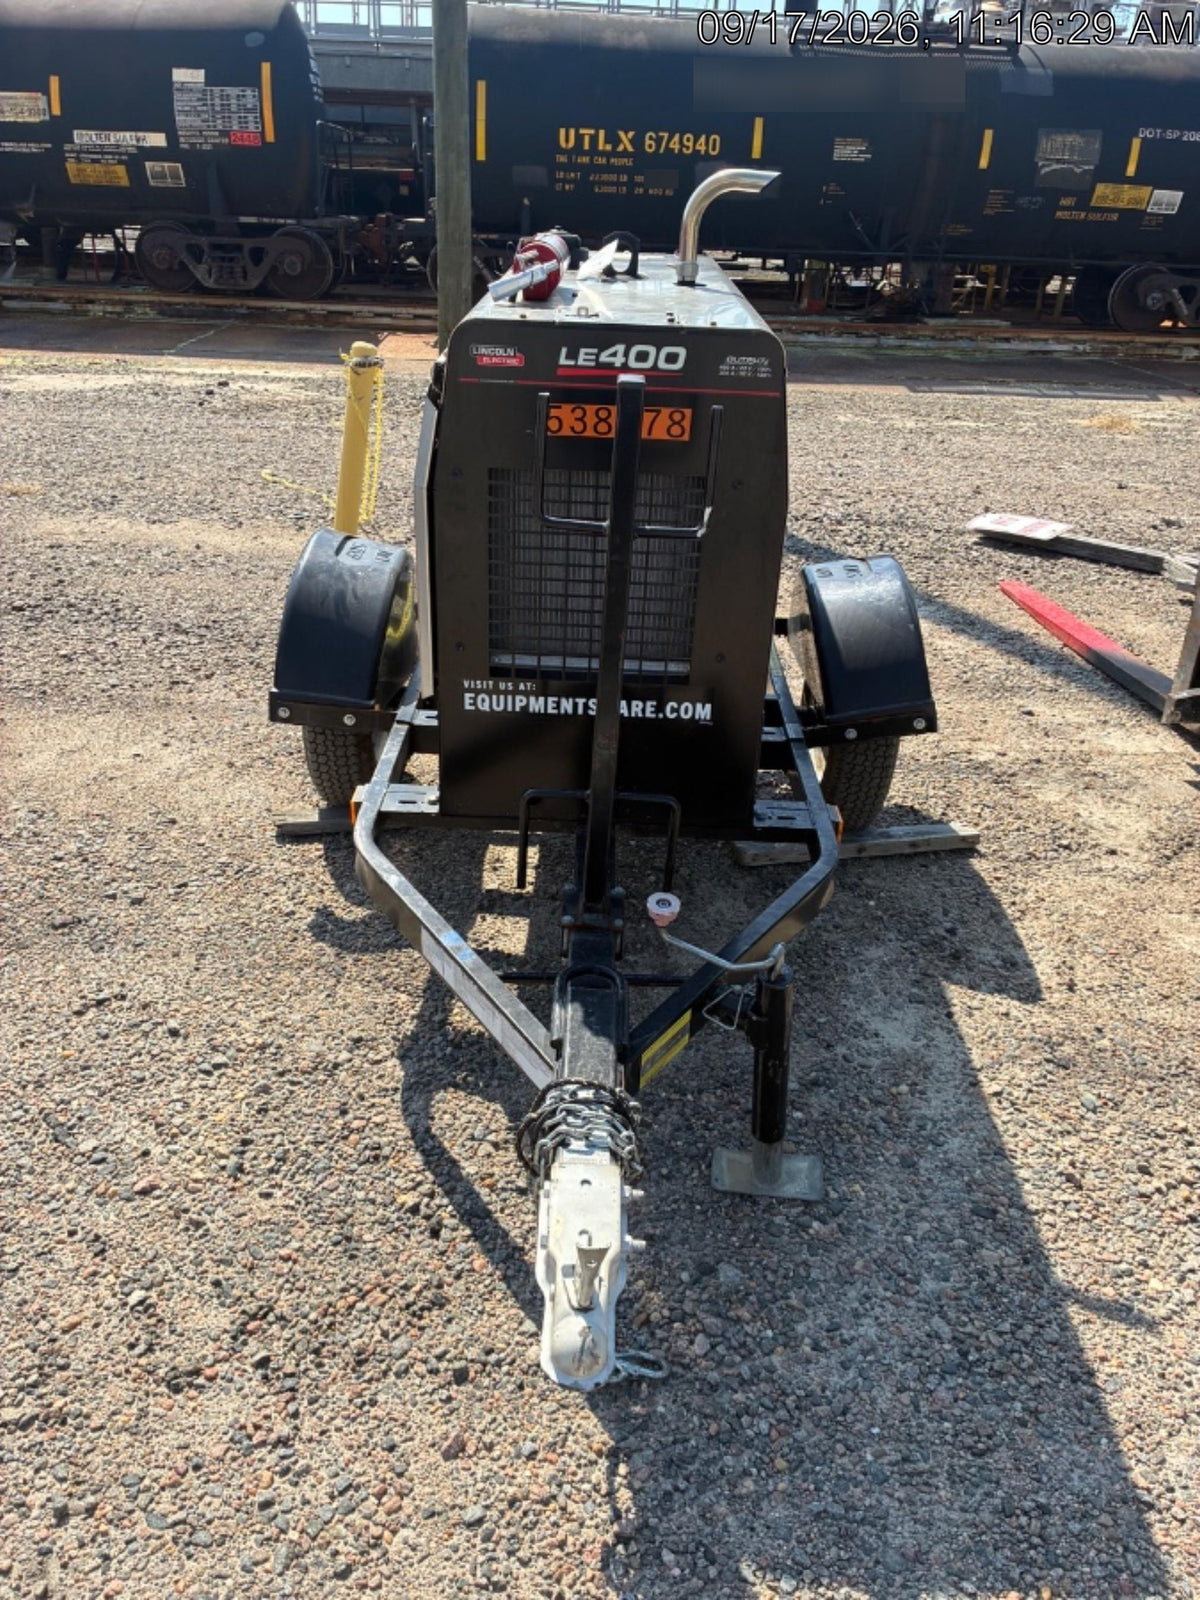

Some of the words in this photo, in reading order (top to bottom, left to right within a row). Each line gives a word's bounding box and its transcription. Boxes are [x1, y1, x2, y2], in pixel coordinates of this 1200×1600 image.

[559, 127, 636, 152] UTLX
[644, 131, 721, 156] 674940
[472, 346, 515, 356] LINCOLN
[482, 356, 520, 366] ELECTRIC
[547, 405, 686, 439] 53878
[463, 680, 494, 690] VISIT
[499, 682, 514, 691] US
[518, 682, 536, 691] AT:
[463, 692, 712, 721] EQUIPMENTSARE.COM
